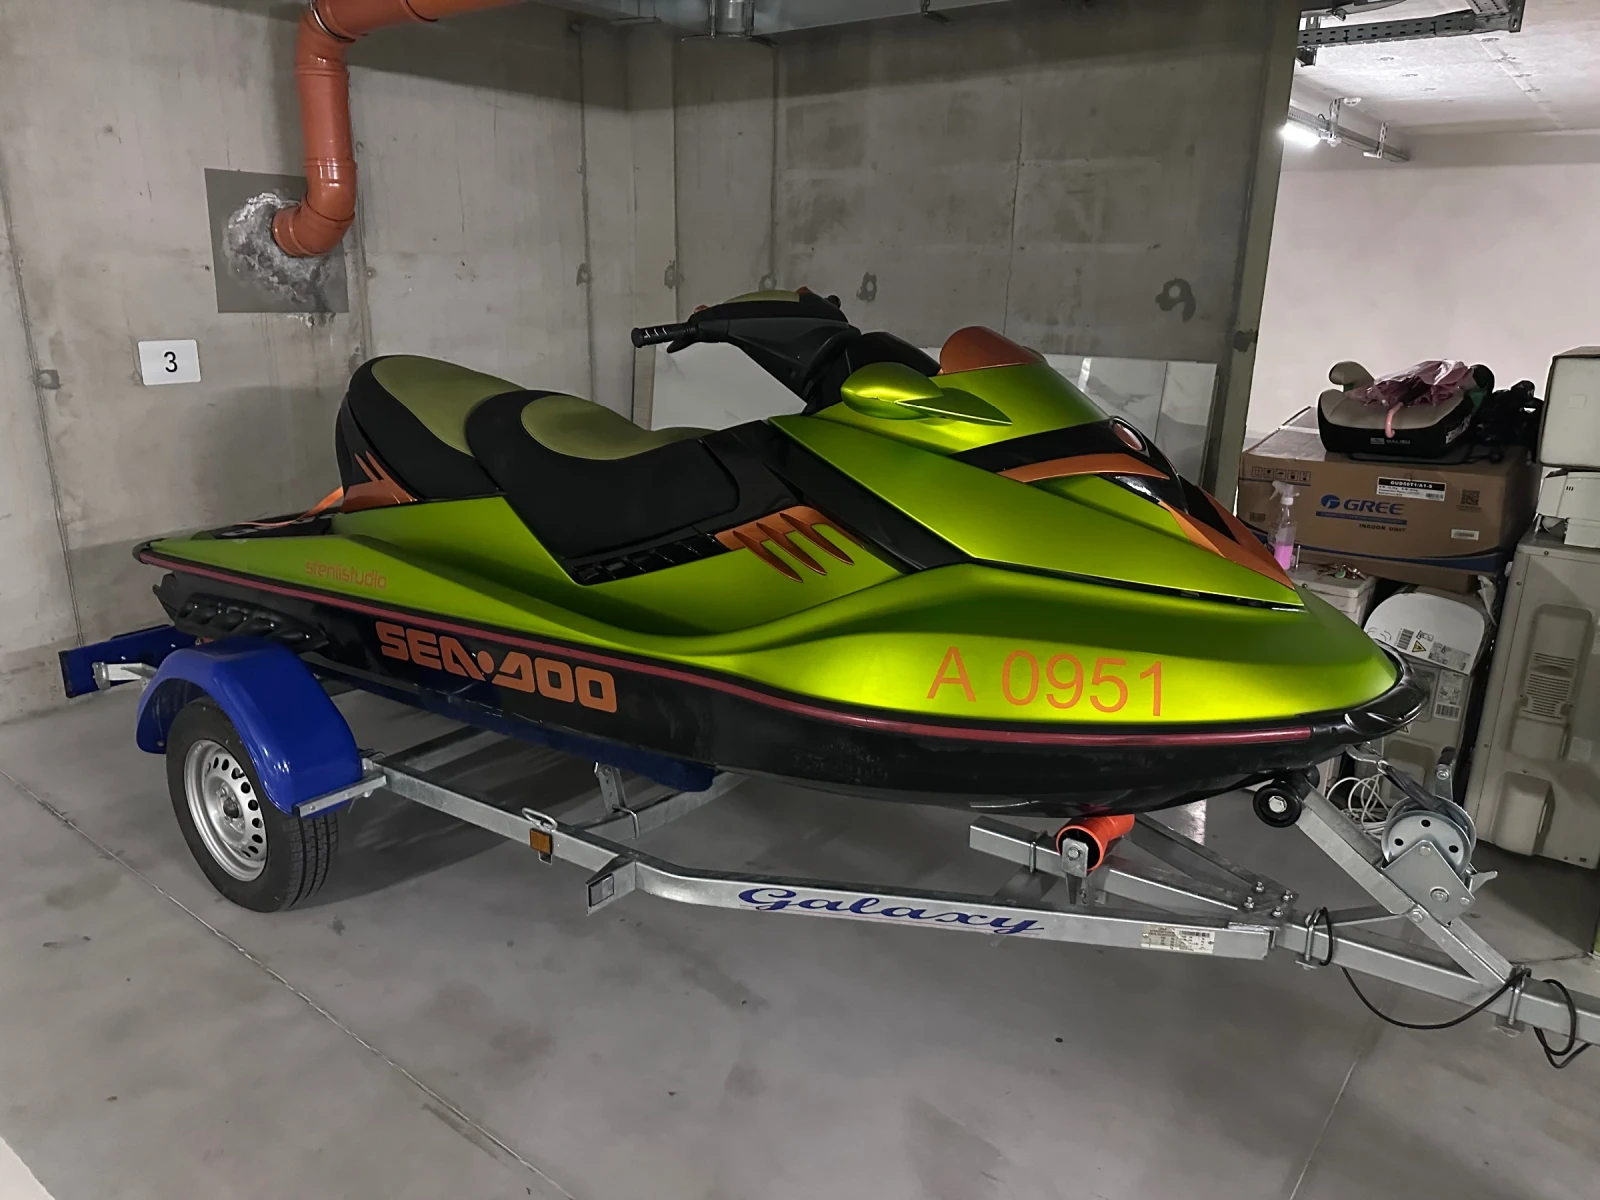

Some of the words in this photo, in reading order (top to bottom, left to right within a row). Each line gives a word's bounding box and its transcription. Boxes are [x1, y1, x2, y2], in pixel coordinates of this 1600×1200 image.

[163, 351, 178, 373] 3
[1344, 499, 1405, 515] GREE
[1359, 523, 1386, 531] INDOOR
[926, 646, 977, 702] A
[1002, 650, 1162, 717] 0951
[738, 887, 1045, 935] Galaxy
